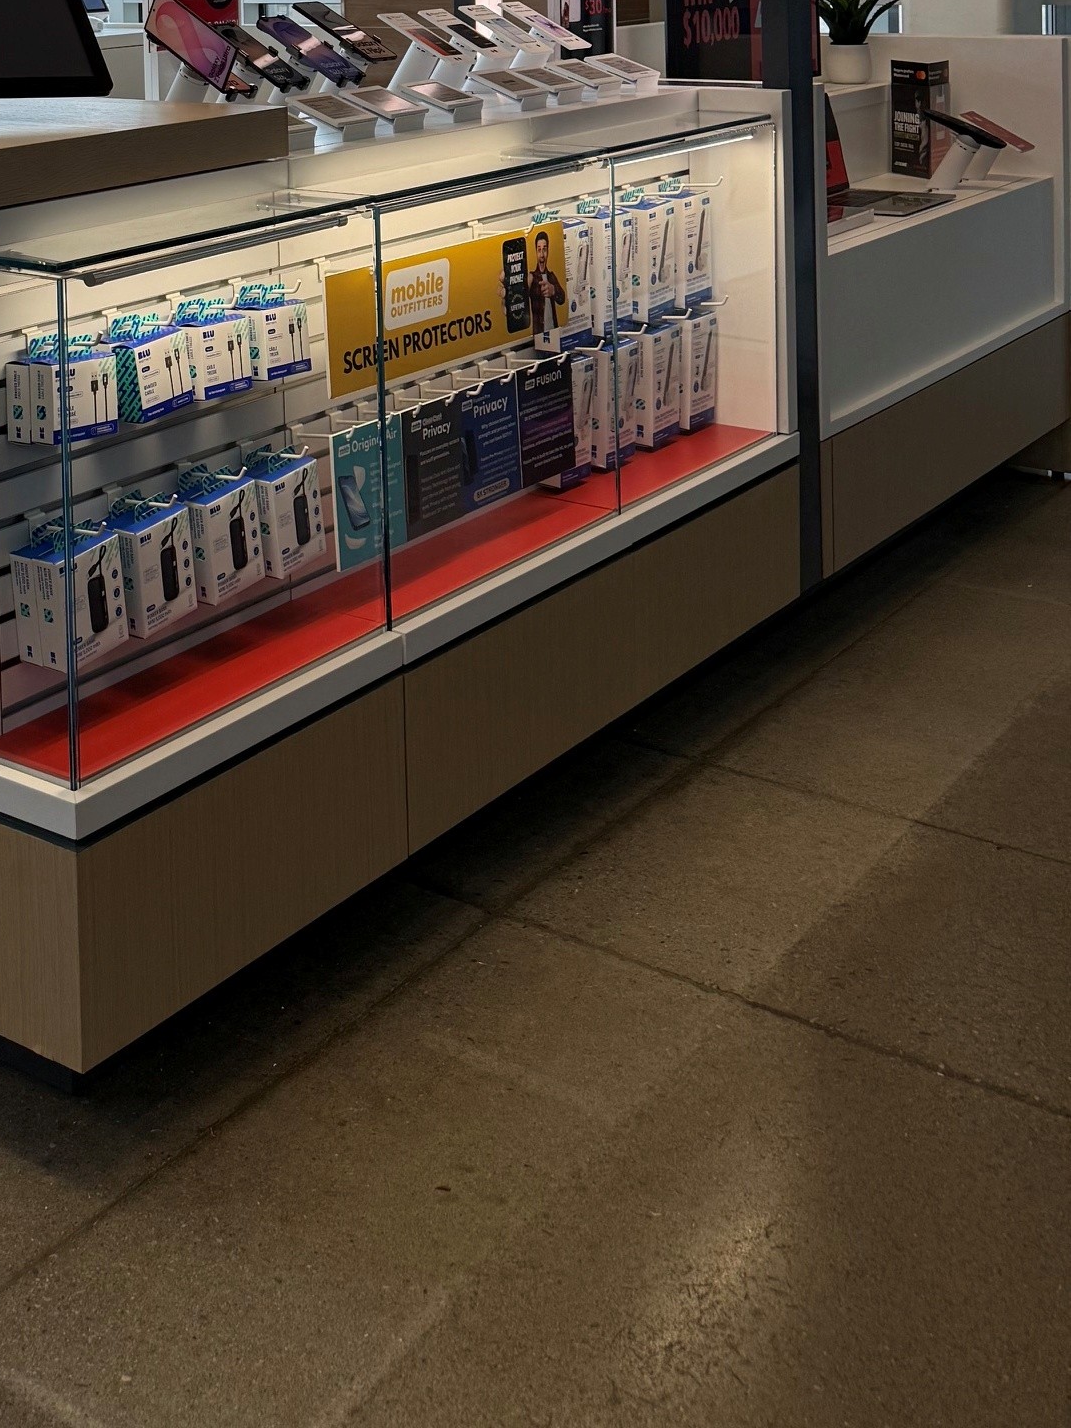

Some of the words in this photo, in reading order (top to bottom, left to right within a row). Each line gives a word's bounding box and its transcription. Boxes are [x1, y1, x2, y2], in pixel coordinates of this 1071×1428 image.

[682, 6, 740, 49] $10,000
[894, 111, 920, 124] JOINING
[894, 121, 905, 132] THE
[904, 123, 920, 134] FIGHT
[506, 251, 524, 264] PROTECT
[391, 272, 444, 305] mobile
[390, 294, 443, 318] OUTFITTERS
[265, 313, 277, 323] BLU
[202, 330, 215, 340] BLU
[343, 336, 400, 374] SCREEN
[403, 310, 492, 356] PROTECTORS
[137, 348, 151, 361] BLU
[55, 368, 76, 379] BU
[473, 396, 508, 418] Privacy
[422, 421, 451, 440] Privacy
[351, 435, 381, 452] Origin
[209, 504, 221, 515] BLU
[139, 533, 152, 545] BLU
